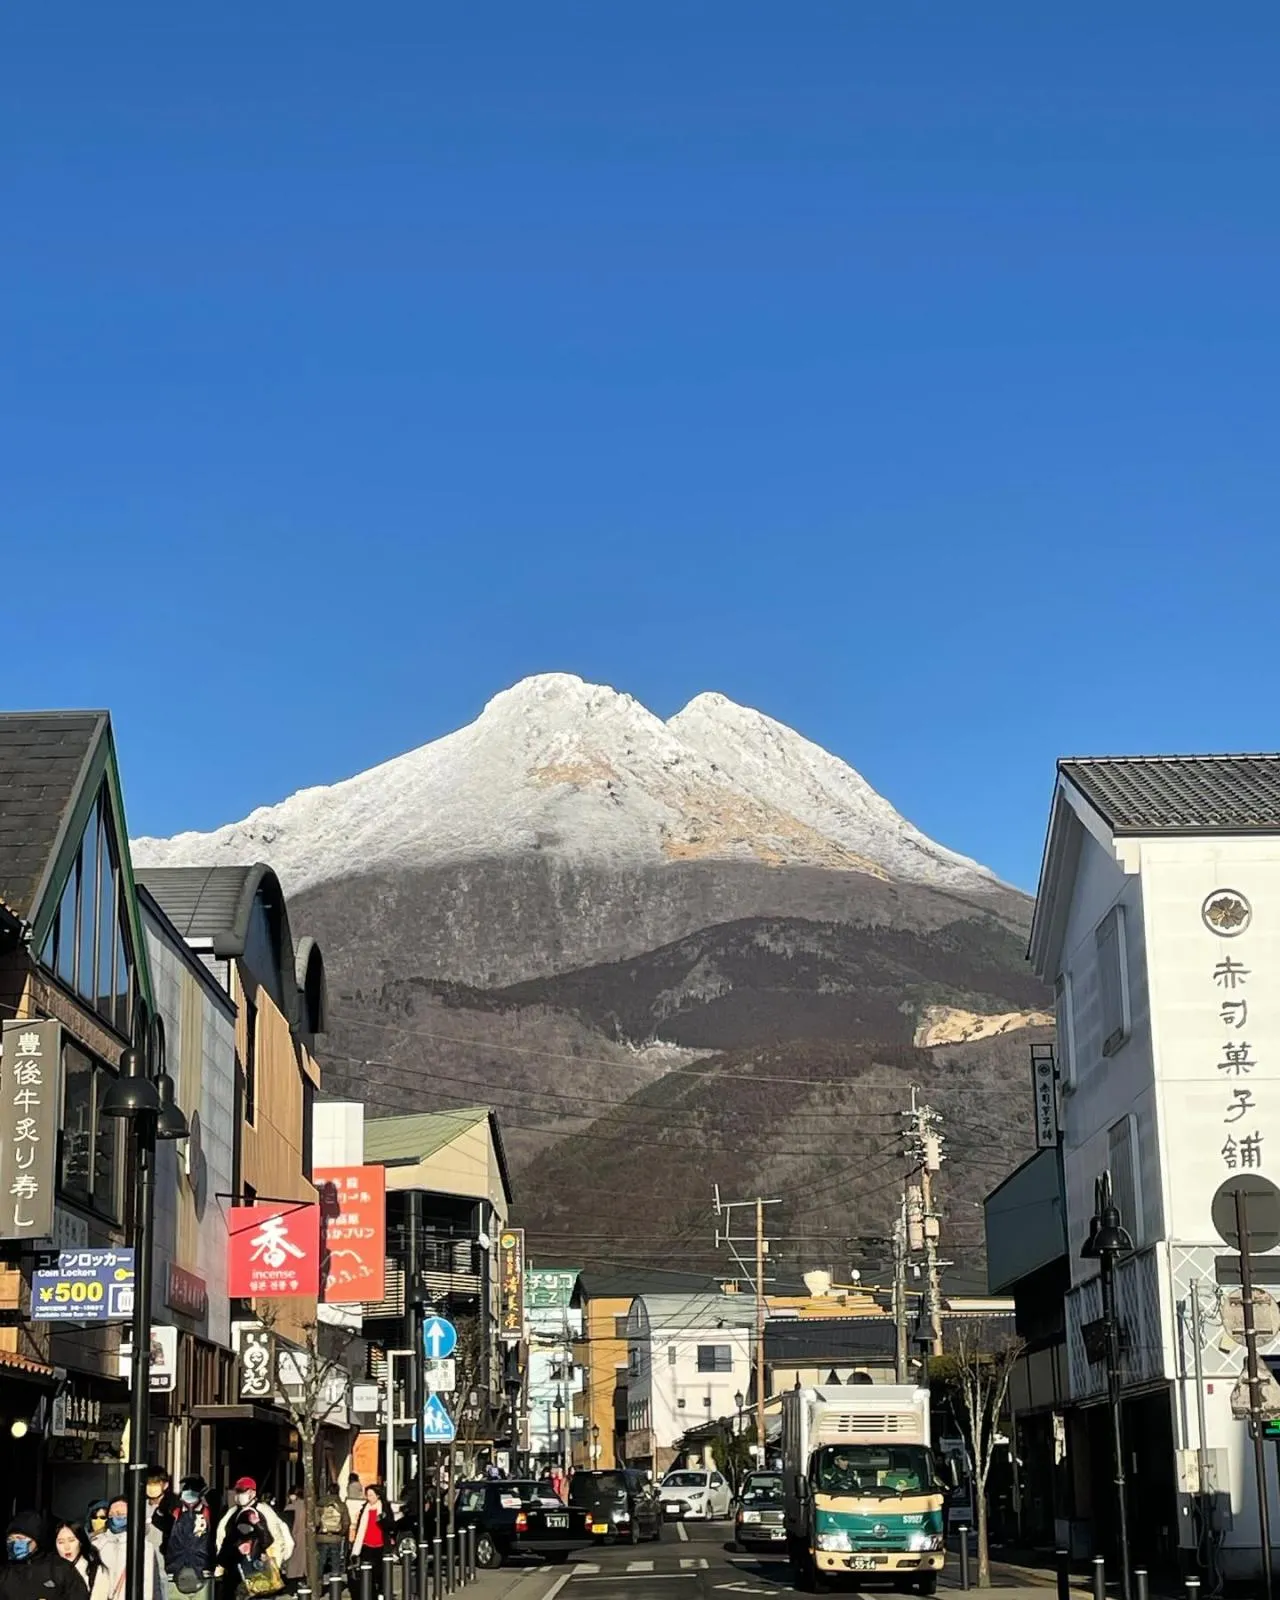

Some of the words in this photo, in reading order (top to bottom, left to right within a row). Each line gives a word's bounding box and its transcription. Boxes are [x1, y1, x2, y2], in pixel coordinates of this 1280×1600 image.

[1213, 956, 1264, 1169] 赤司菓子舗
[9, 1032, 43, 1227] 豊後牛炙り寿し
[249, 1213, 307, 1268] 香
[39, 1252, 132, 1268] コインロッカー
[38, 1269, 59, 1277] Coin
[61, 1268, 97, 1277] Lockers
[251, 1269, 297, 1280] incense
[524, 1273, 574, 1290] チンコ
[39, 1281, 104, 1303] ¥500
